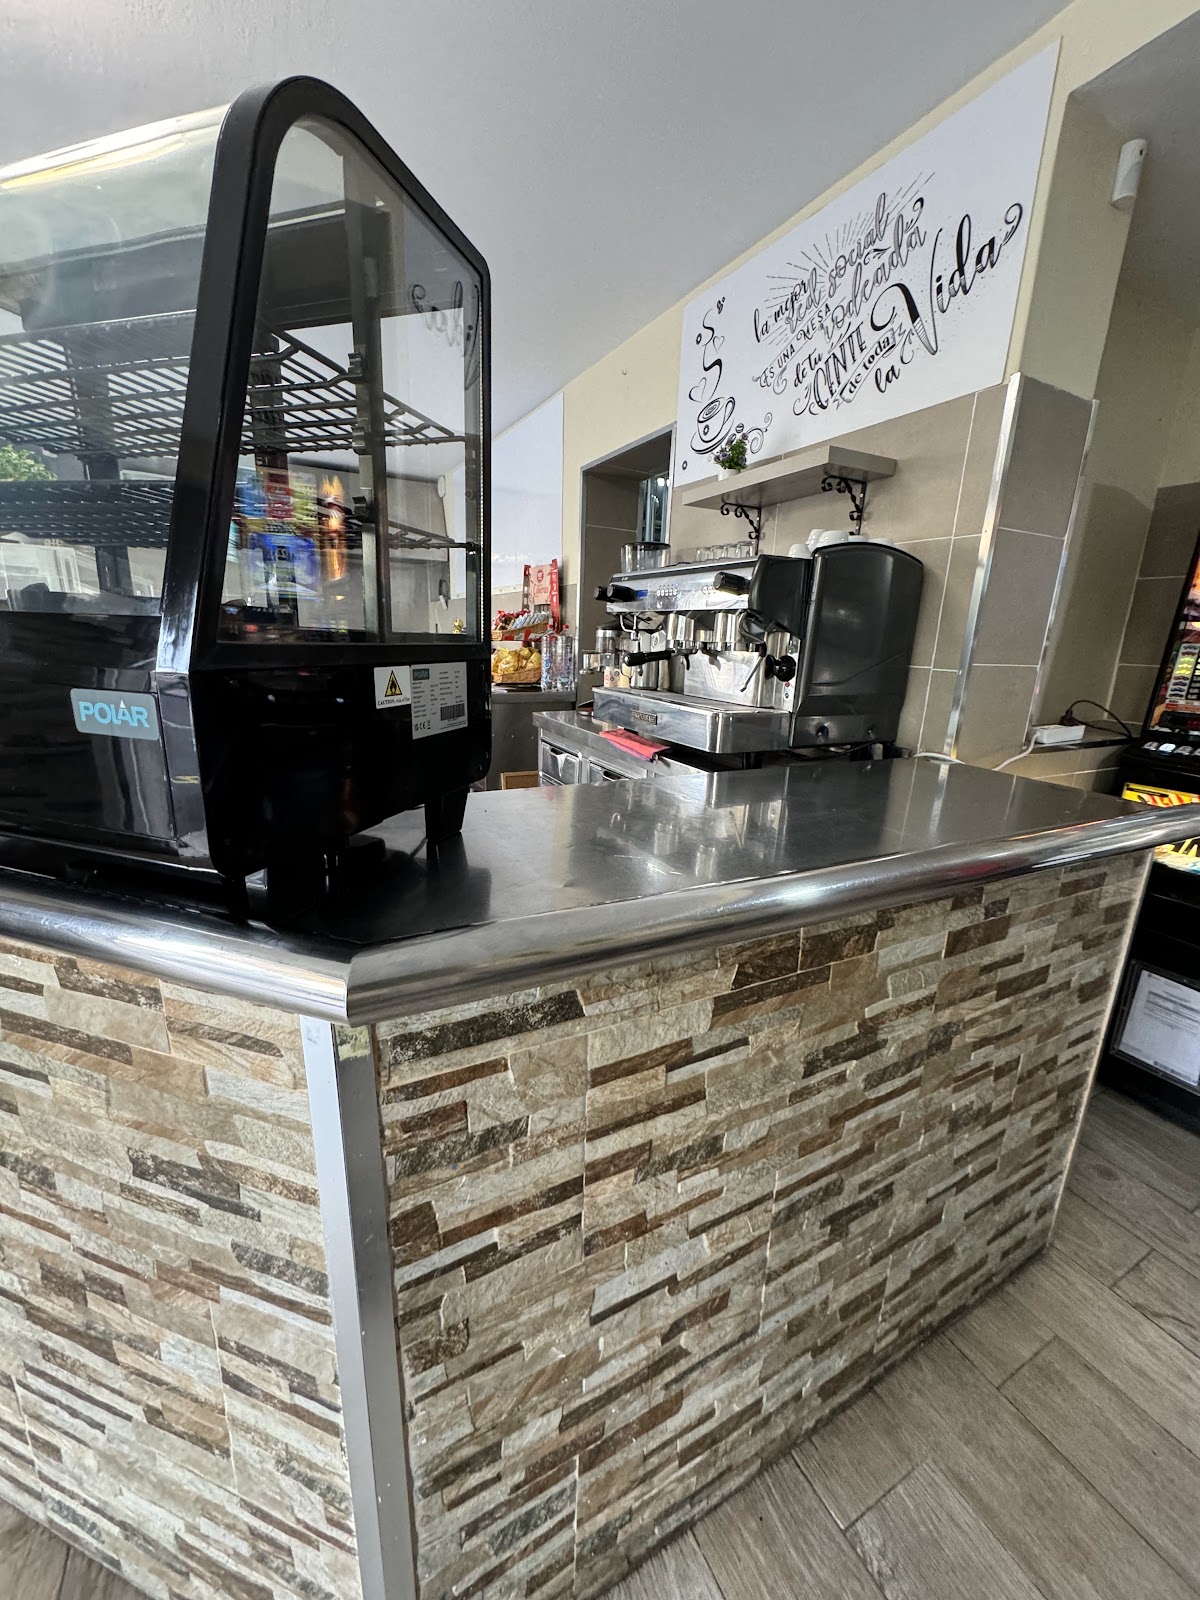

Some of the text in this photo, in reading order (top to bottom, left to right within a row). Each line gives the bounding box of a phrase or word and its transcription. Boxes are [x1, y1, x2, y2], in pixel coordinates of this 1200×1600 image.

[785, 192, 890, 334] red social
[818, 198, 927, 344] rodeada
[870, 203, 1023, 394] la Vida
[753, 280, 808, 343] la mejor
[757, 302, 832, 388] ES UNA MESA
[793, 348, 824, 388] de tu
[847, 335, 891, 395] de toda
[78, 700, 150, 728] POLAR
